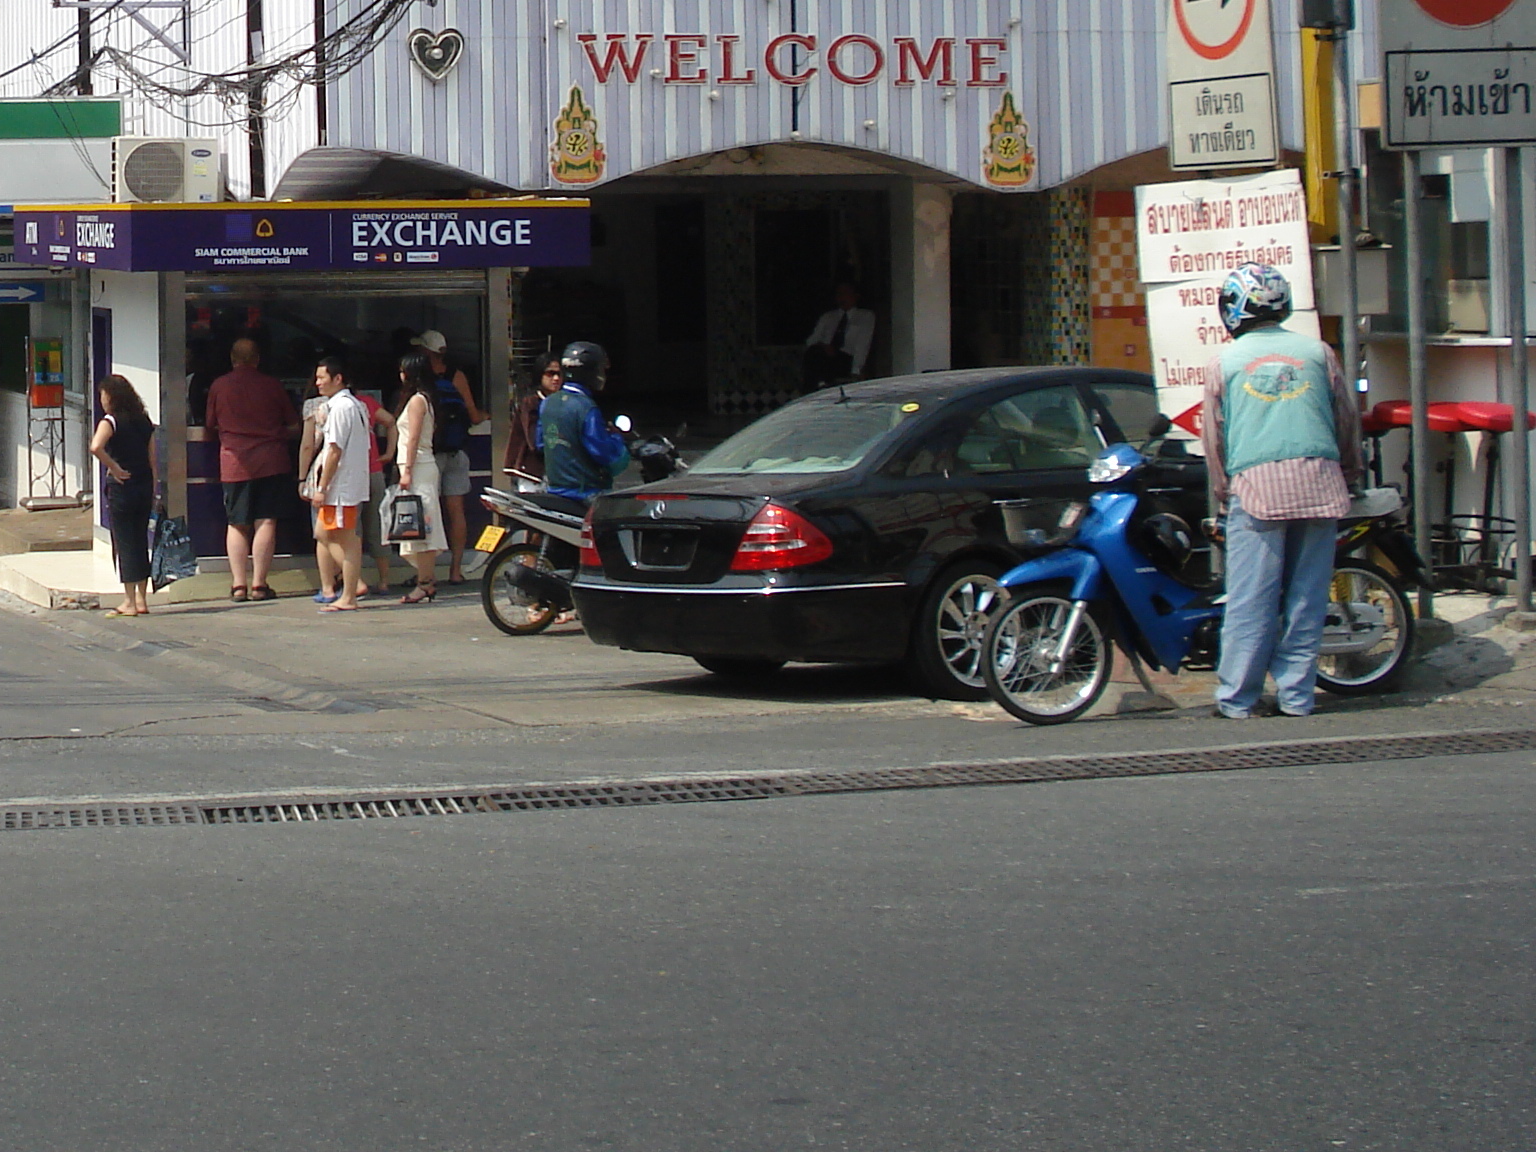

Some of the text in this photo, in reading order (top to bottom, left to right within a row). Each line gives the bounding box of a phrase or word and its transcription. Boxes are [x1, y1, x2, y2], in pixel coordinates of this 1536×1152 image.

[577, 33, 1009, 88] WELCOME
[1196, 87, 1244, 116] เดินรถ
[1405, 68, 1531, 117] ห้ามเข้า
[1189, 121, 1255, 153] ทางเดียว
[352, 213, 390, 221] CURRENCY
[431, 212, 459, 220] SERVICE
[1147, 186, 1233, 234] สบายแลนด์
[76, 223, 115, 248] EXCHANGE
[352, 219, 532, 247] EXCHANGE
[195, 247, 309, 257] SIAM COMMERCIAL BANK
